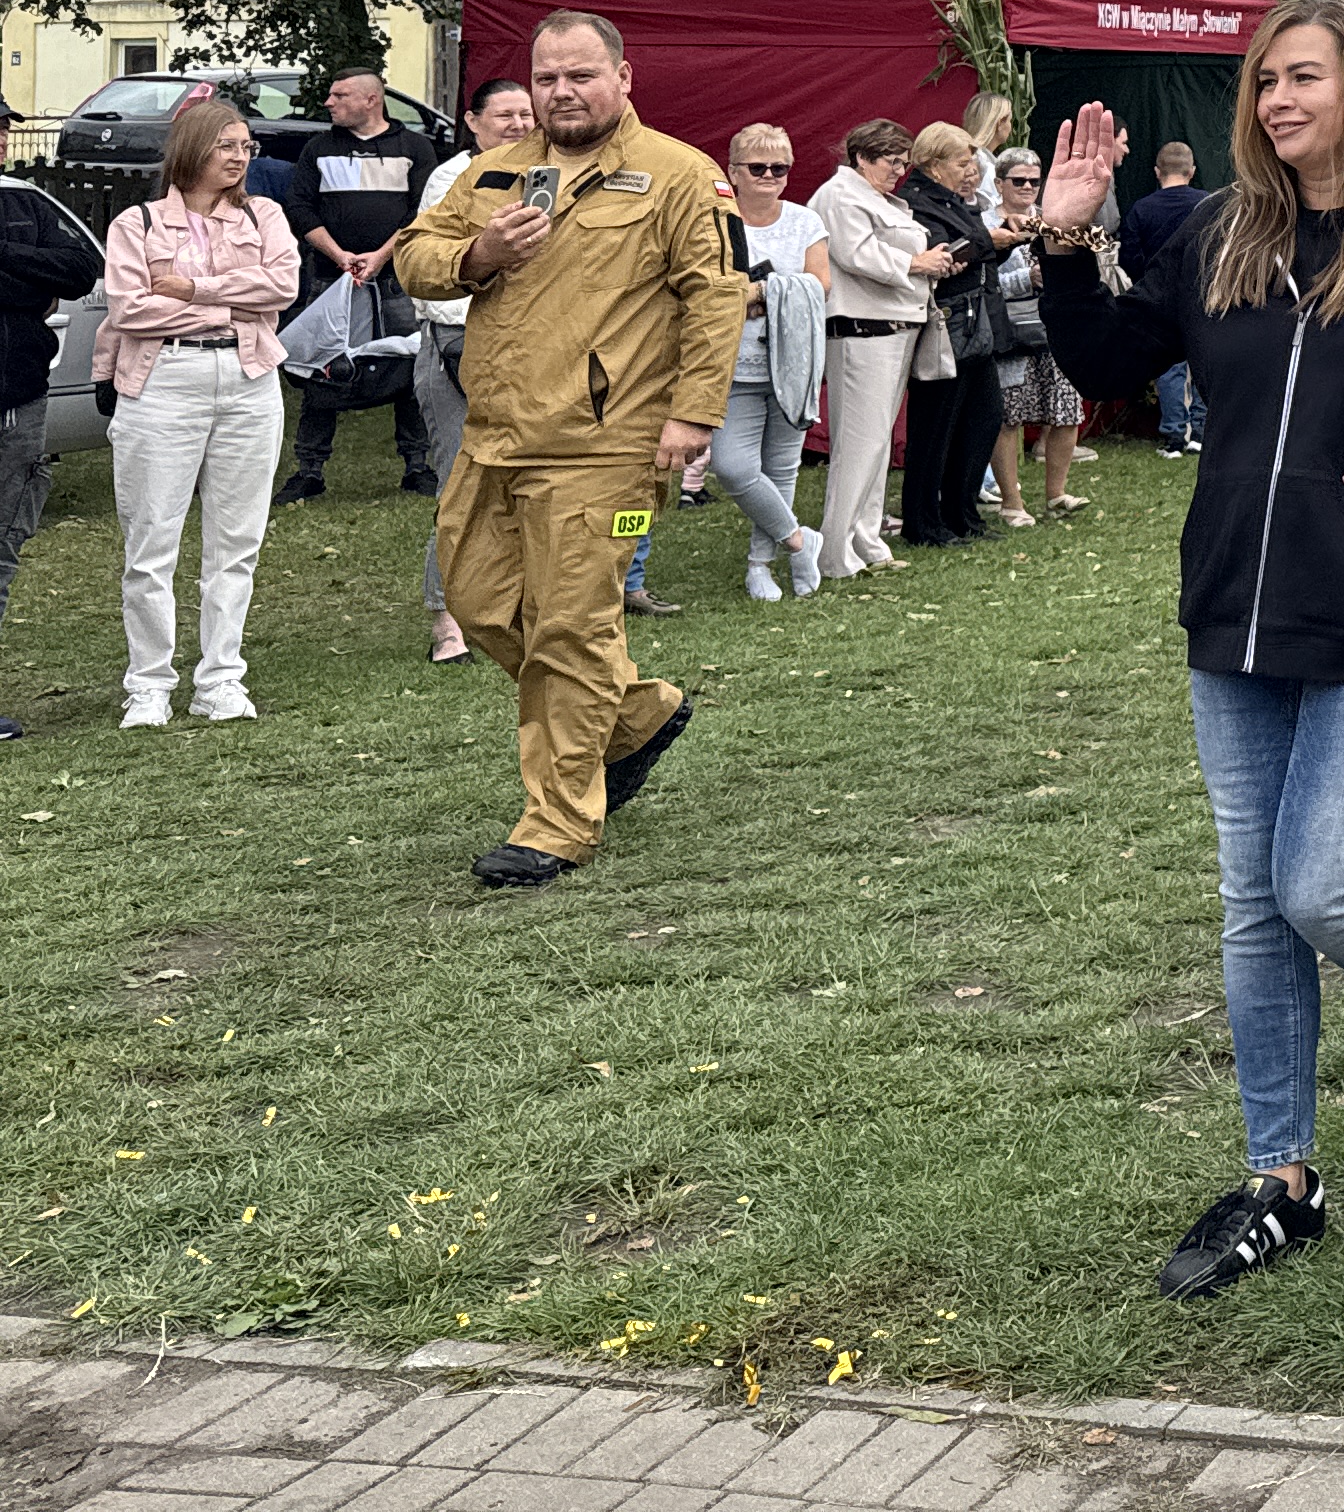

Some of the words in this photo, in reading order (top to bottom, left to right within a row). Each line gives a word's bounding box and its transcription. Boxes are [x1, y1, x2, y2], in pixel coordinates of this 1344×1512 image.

[1097, 3, 1121, 29] KGW
[1121, 11, 1131, 29] w
[617, 514, 645, 534] OSP
